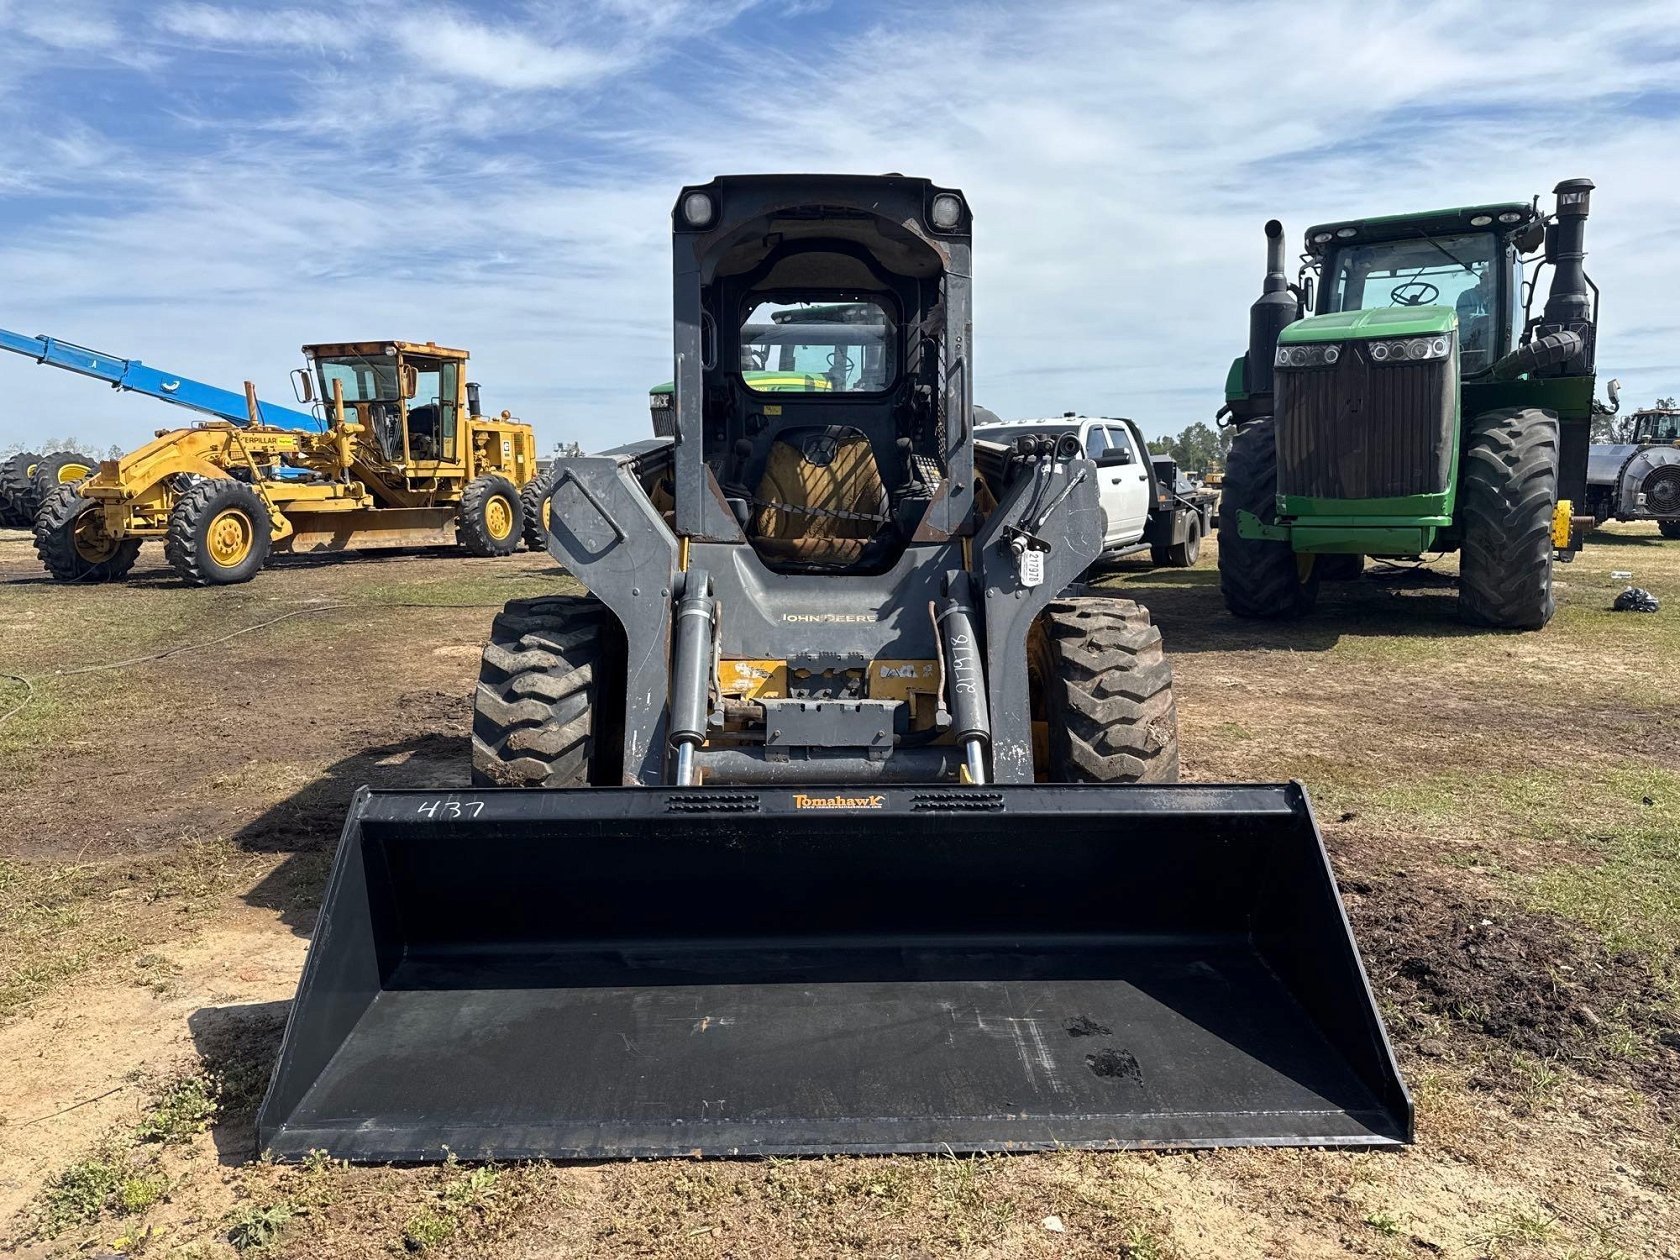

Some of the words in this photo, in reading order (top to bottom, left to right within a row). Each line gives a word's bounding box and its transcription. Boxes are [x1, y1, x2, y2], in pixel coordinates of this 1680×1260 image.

[231, 436, 277, 444] CERPILLAR
[1028, 553, 1039, 582] 217978
[417, 800, 485, 818] 437
